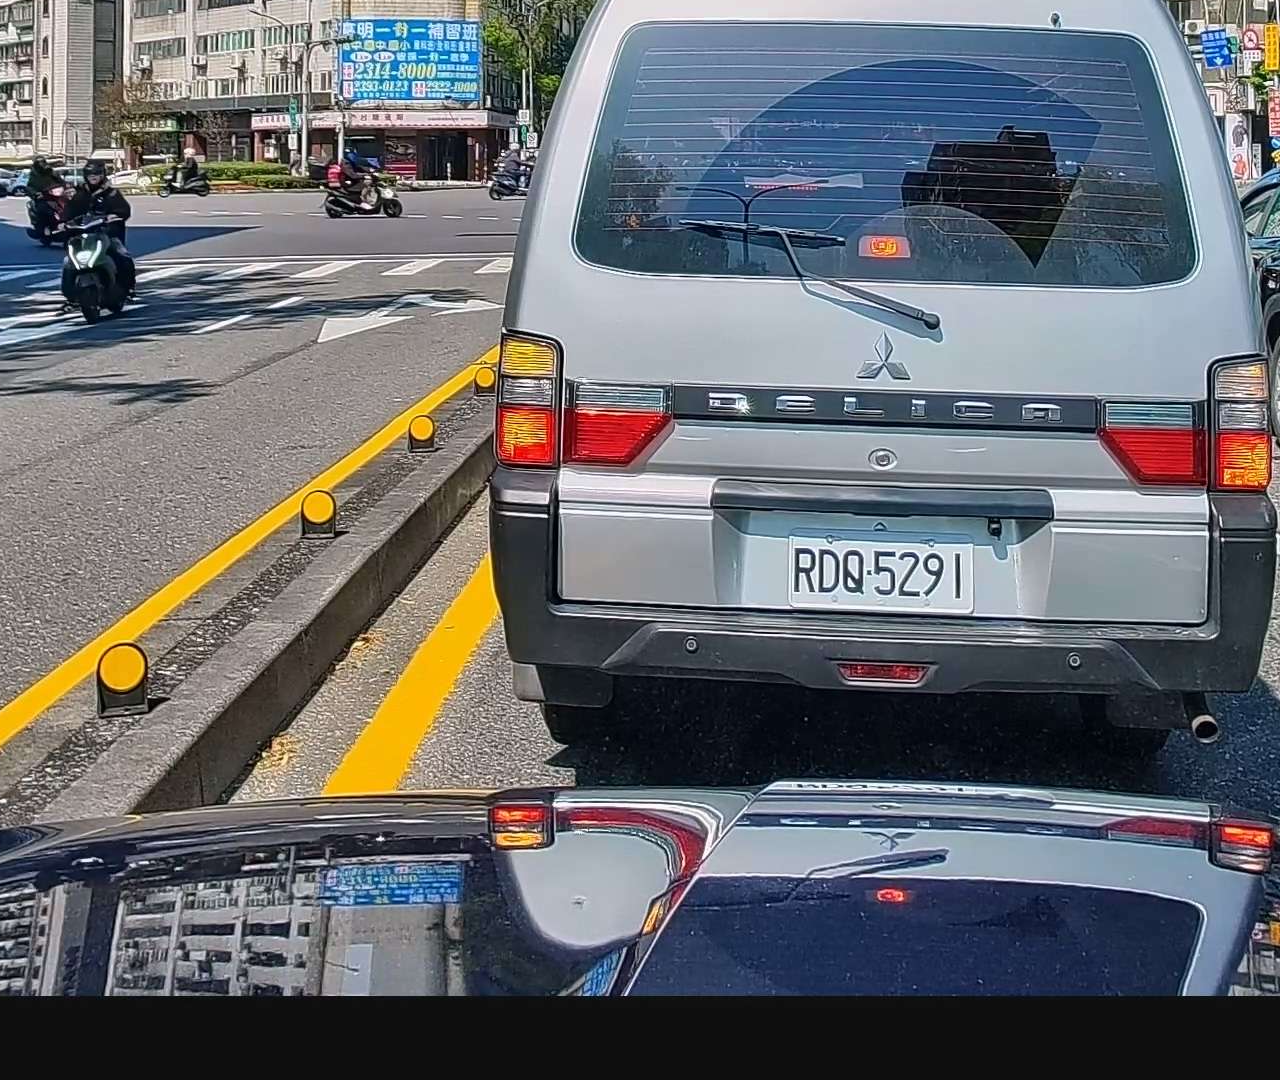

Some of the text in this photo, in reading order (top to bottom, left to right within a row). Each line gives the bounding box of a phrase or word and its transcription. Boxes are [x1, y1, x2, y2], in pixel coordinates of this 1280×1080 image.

[354, 62, 437, 80] 2314-8000
[708, 391, 1063, 422] DELICA
[793, 546, 963, 600] RDQ-5291
